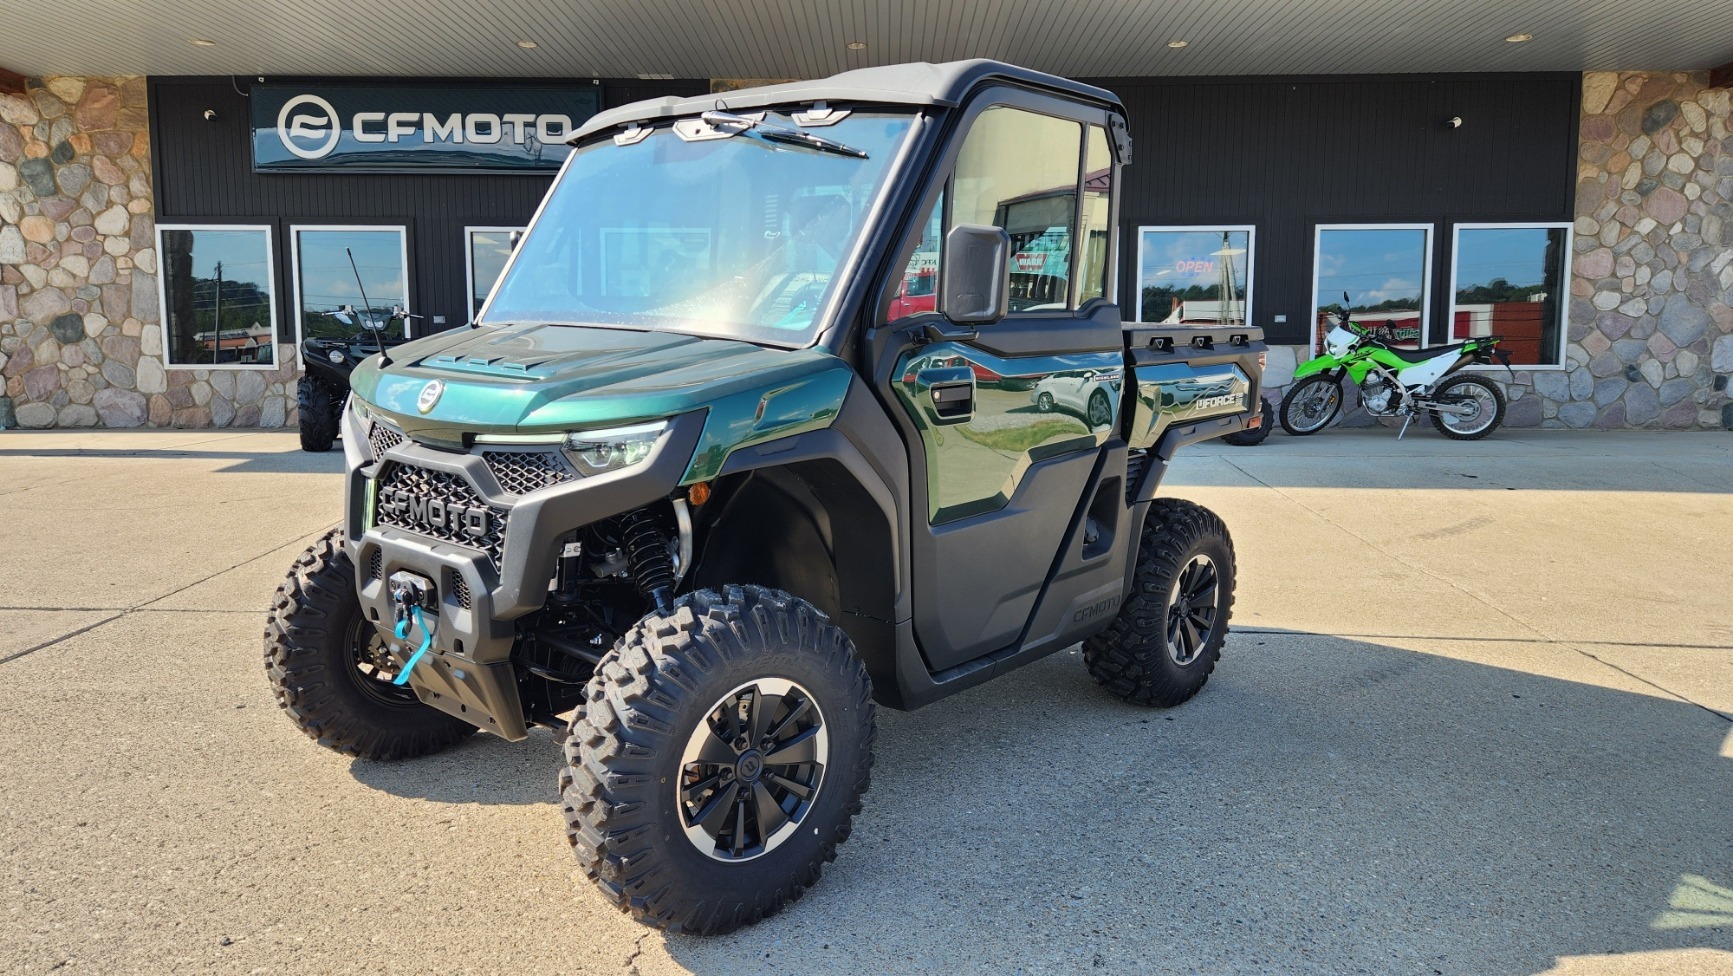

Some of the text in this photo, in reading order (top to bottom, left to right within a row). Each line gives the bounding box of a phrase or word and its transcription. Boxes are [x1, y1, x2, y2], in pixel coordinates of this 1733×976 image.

[352, 112, 573, 145] CFMOTO
[1176, 261, 1213, 273] OPEN
[382, 486, 487, 536] CFMOTO
[1073, 595, 1121, 623] CFMOTO
